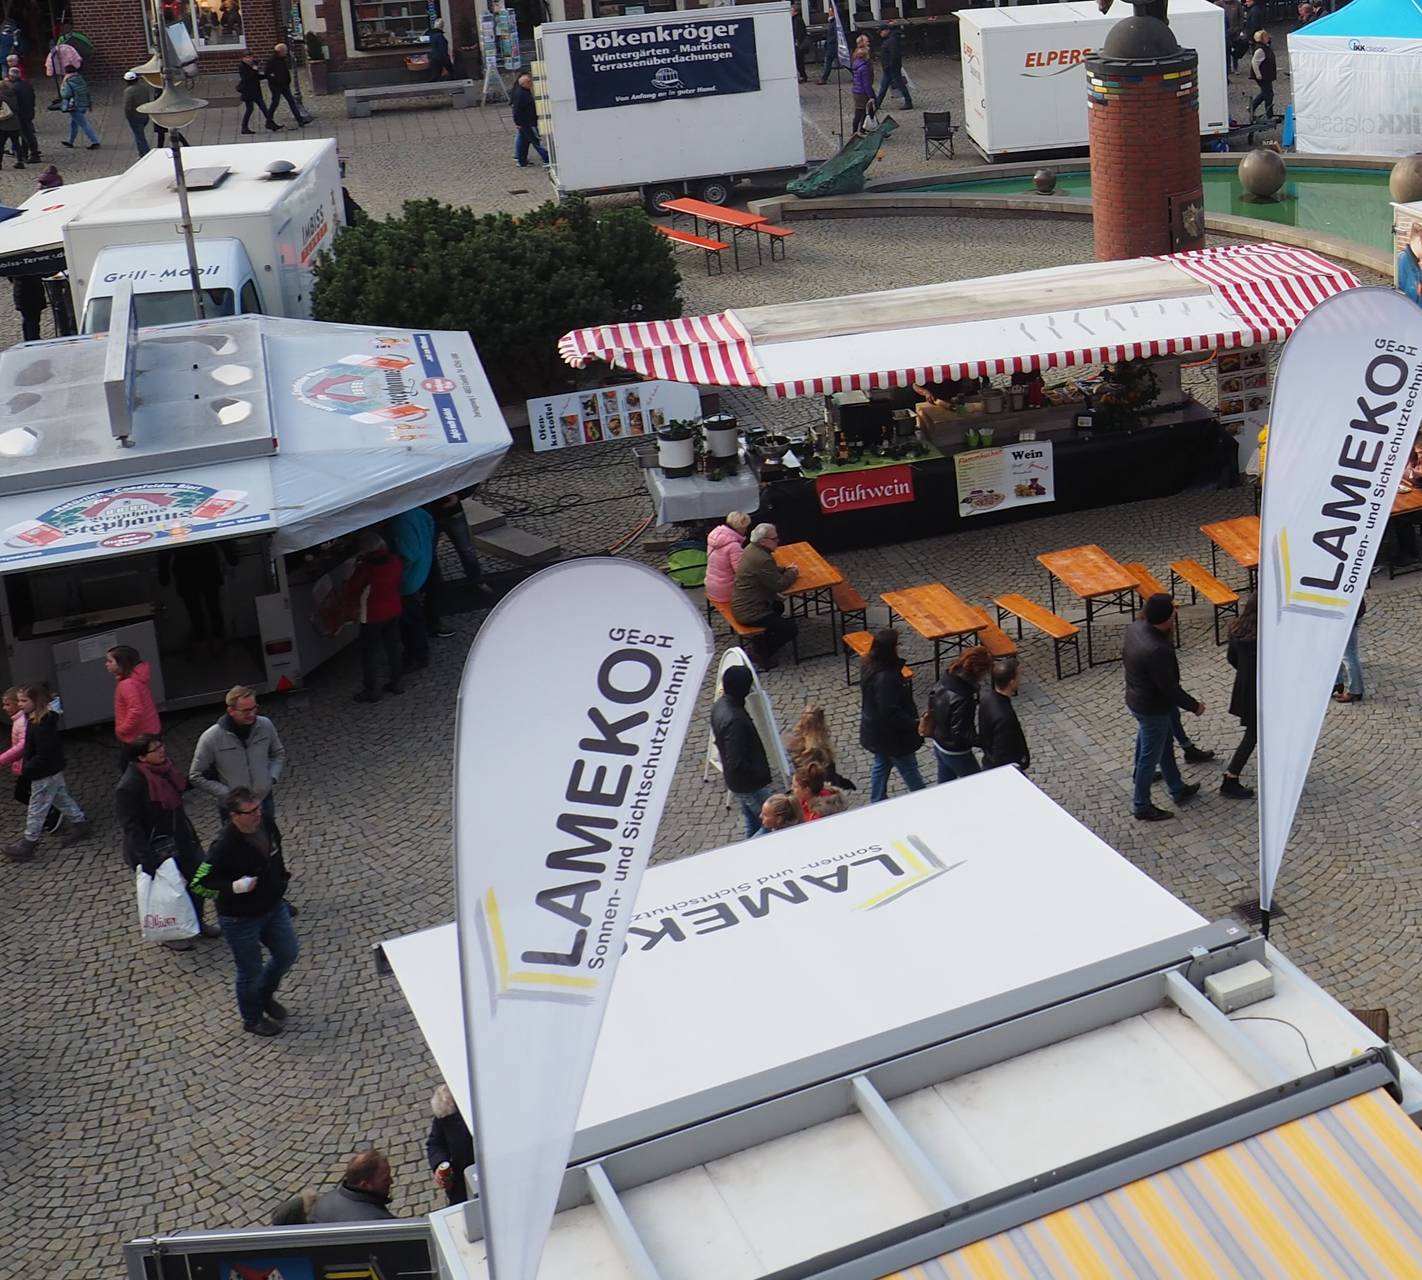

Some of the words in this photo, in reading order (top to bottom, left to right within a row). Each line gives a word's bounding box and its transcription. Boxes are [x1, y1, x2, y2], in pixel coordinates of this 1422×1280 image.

[579, 23, 739, 50] Bökenkröger
[592, 46, 670, 62] Wintergärten
[679, 41, 731, 54] Markisen
[592, 51, 733, 72] Terrassenüberdachungen
[1025, 48, 1093, 68] ELPERS
[631, 92, 657, 100] Anfang
[677, 88, 696, 96] guter
[1375, 338, 1418, 357] GmbH
[1012, 449, 1043, 460] Wein
[1300, 354, 1409, 591] LAMEKO
[820, 479, 911, 509] Glühwein
[1343, 535, 1370, 593] Sonnen-
[1366, 502, 1381, 532] und
[609, 627, 675, 648] GmbH
[622, 653, 693, 839] Sichtschutztechnik
[521, 648, 662, 967] LAMEKO
[614, 846, 634, 881] und
[800, 844, 882, 870] Sonnen-
[758, 867, 795, 886] und
[621, 853, 905, 956] LAMEK
[631, 881, 752, 921] Sichtschutz
[588, 888, 621, 969] Sonnen-
